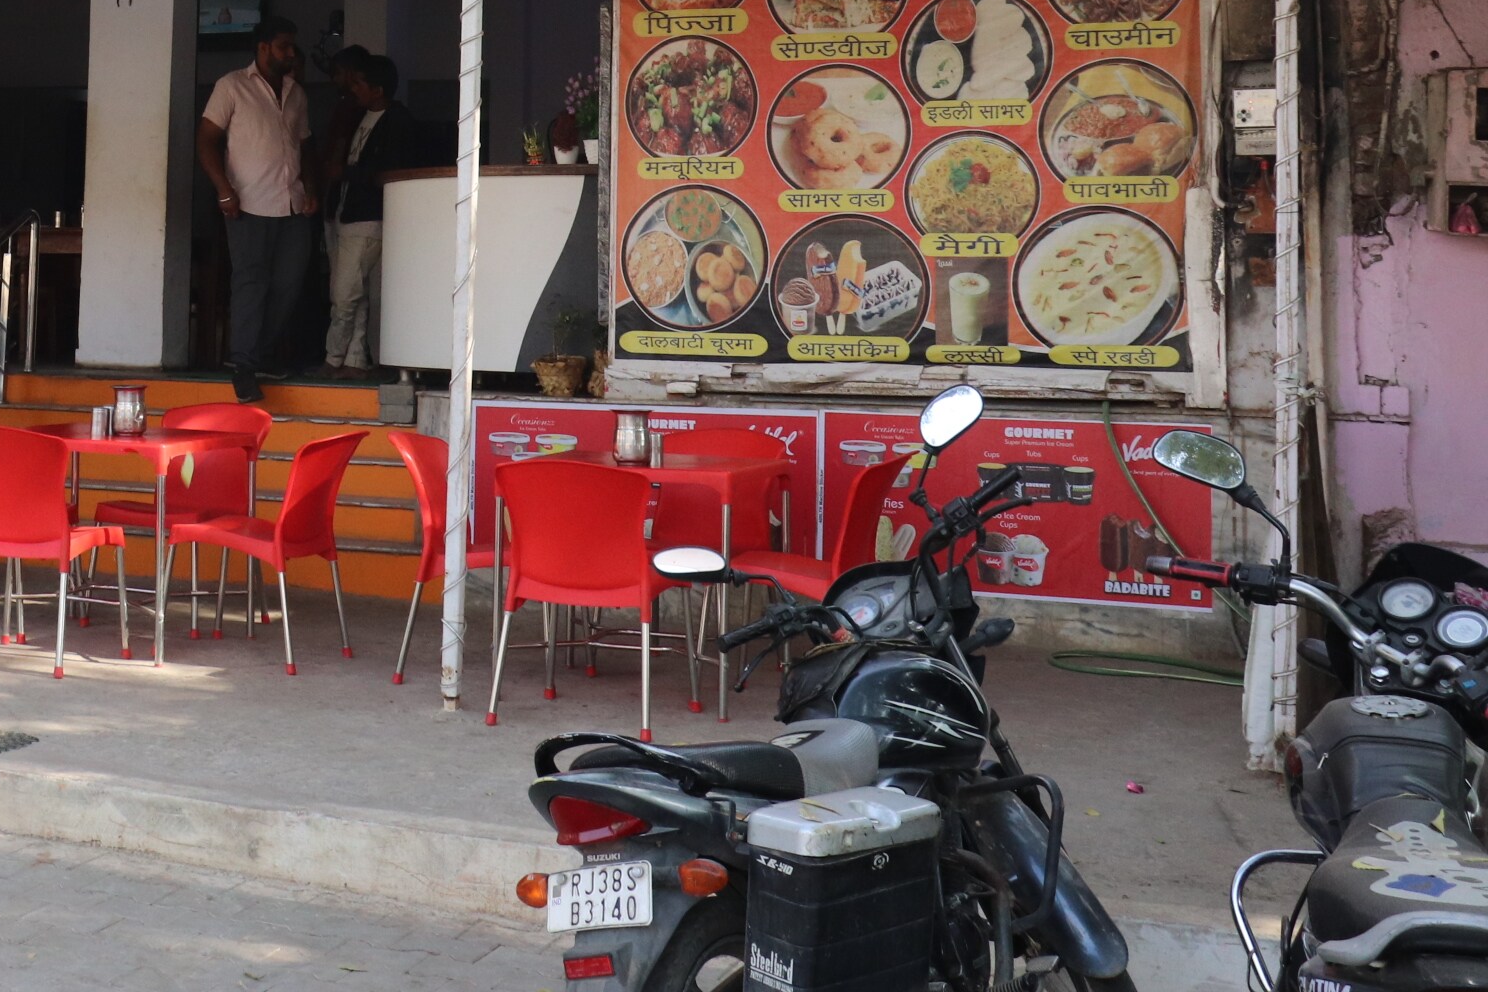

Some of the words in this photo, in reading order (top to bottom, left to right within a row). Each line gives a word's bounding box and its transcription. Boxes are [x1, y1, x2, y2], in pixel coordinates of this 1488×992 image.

[644, 11, 737, 35] पिज्जा
[1068, 22, 1177, 47] चाउमीन
[926, 100, 974, 123] इडली
[1069, 179, 1170, 199] पावभाजी
[847, 193, 887, 208] वडा
[932, 233, 1006, 255] मैगी
[710, 337, 755, 355] चूरमा
[942, 346, 1005, 363] लस्सी
[648, 419, 696, 431] URMET
[1004, 427, 1074, 440] GOURMET
[984, 450, 1000, 459] Cups
[1026, 450, 1042, 458] Tubs
[1072, 454, 1089, 463] Cups
[1003, 512, 1014, 520] Ice
[1016, 512, 1041, 521] Cream
[999, 520, 1018, 530] Cups
[1104, 581, 1171, 597] BADABITE
[587, 853, 621, 862] SUZUKI
[570, 868, 637, 898] RJ38S
[570, 896, 637, 926] B3140
[750, 942, 794, 983] Steelbird
